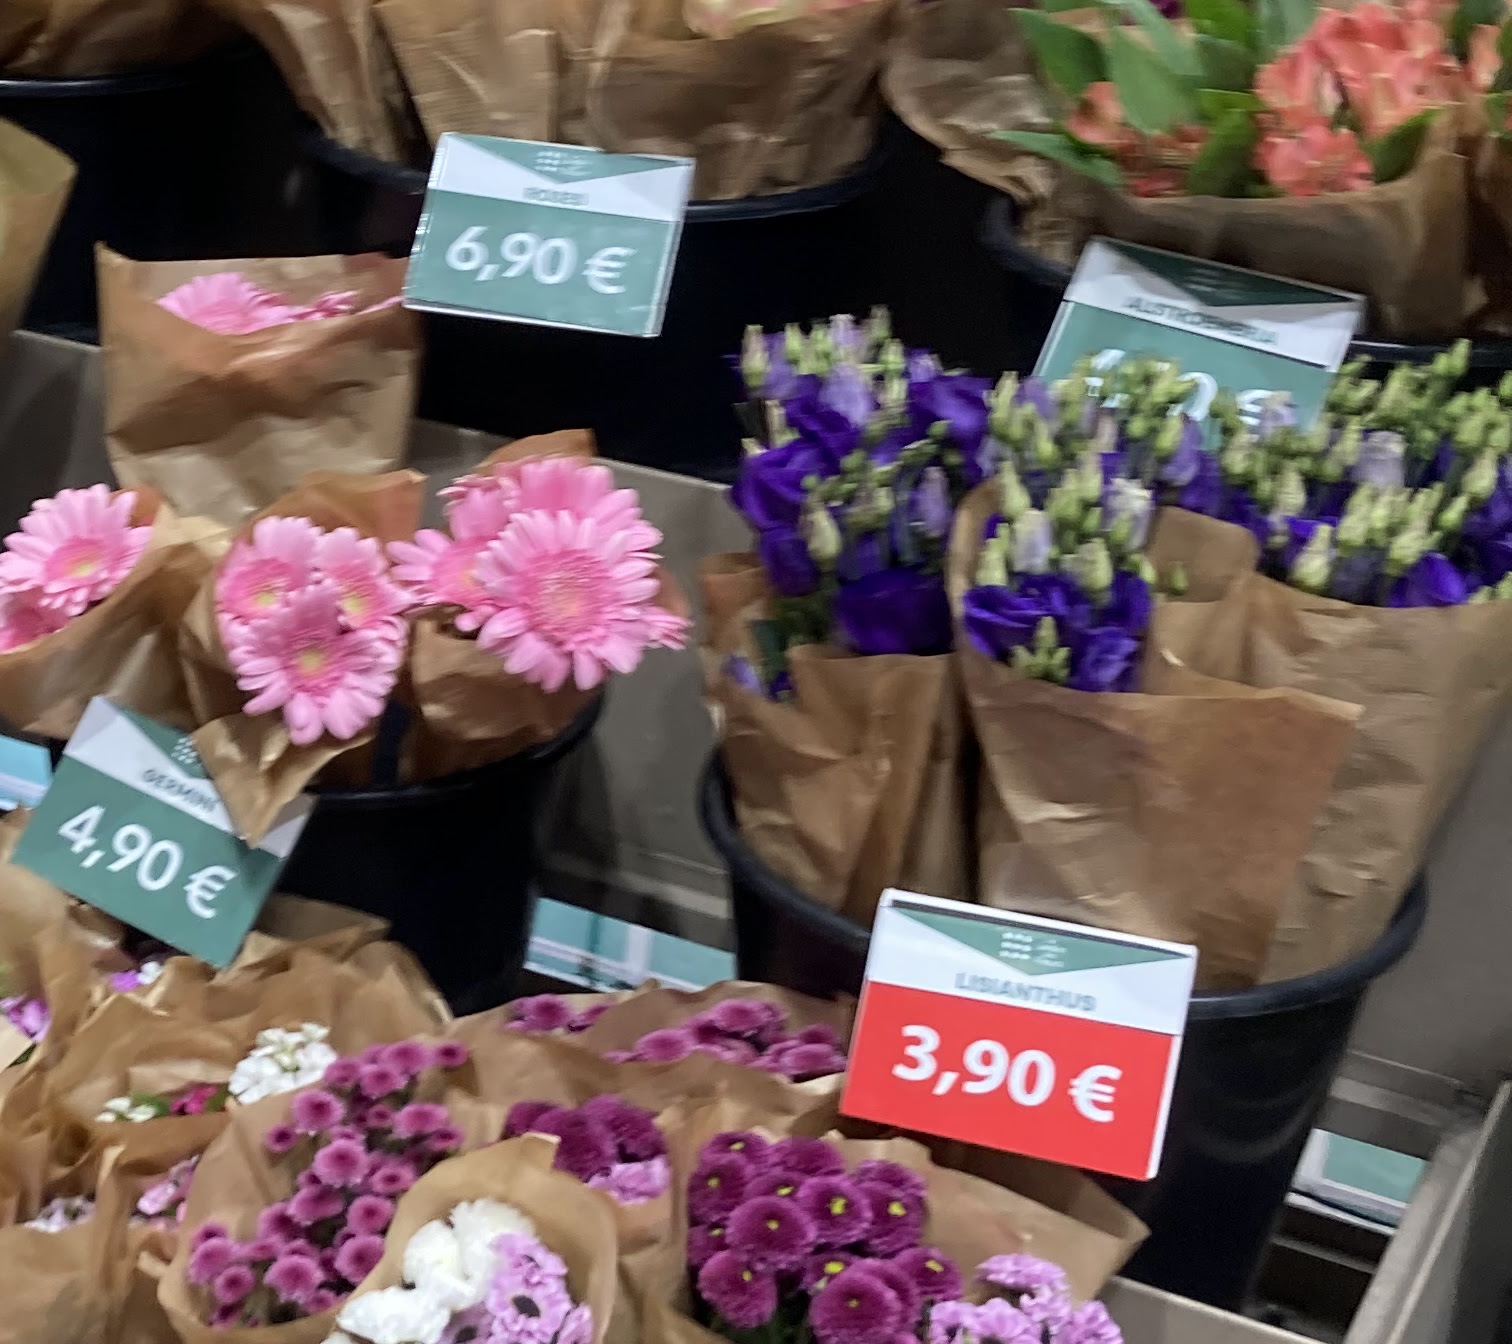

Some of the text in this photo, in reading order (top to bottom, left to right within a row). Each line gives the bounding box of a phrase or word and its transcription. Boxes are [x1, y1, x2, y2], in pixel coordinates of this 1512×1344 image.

[444, 225, 639, 295] 6,90 €
[57, 804, 239, 920] 4,90 €
[891, 1023, 1124, 1123] 3,90 €
